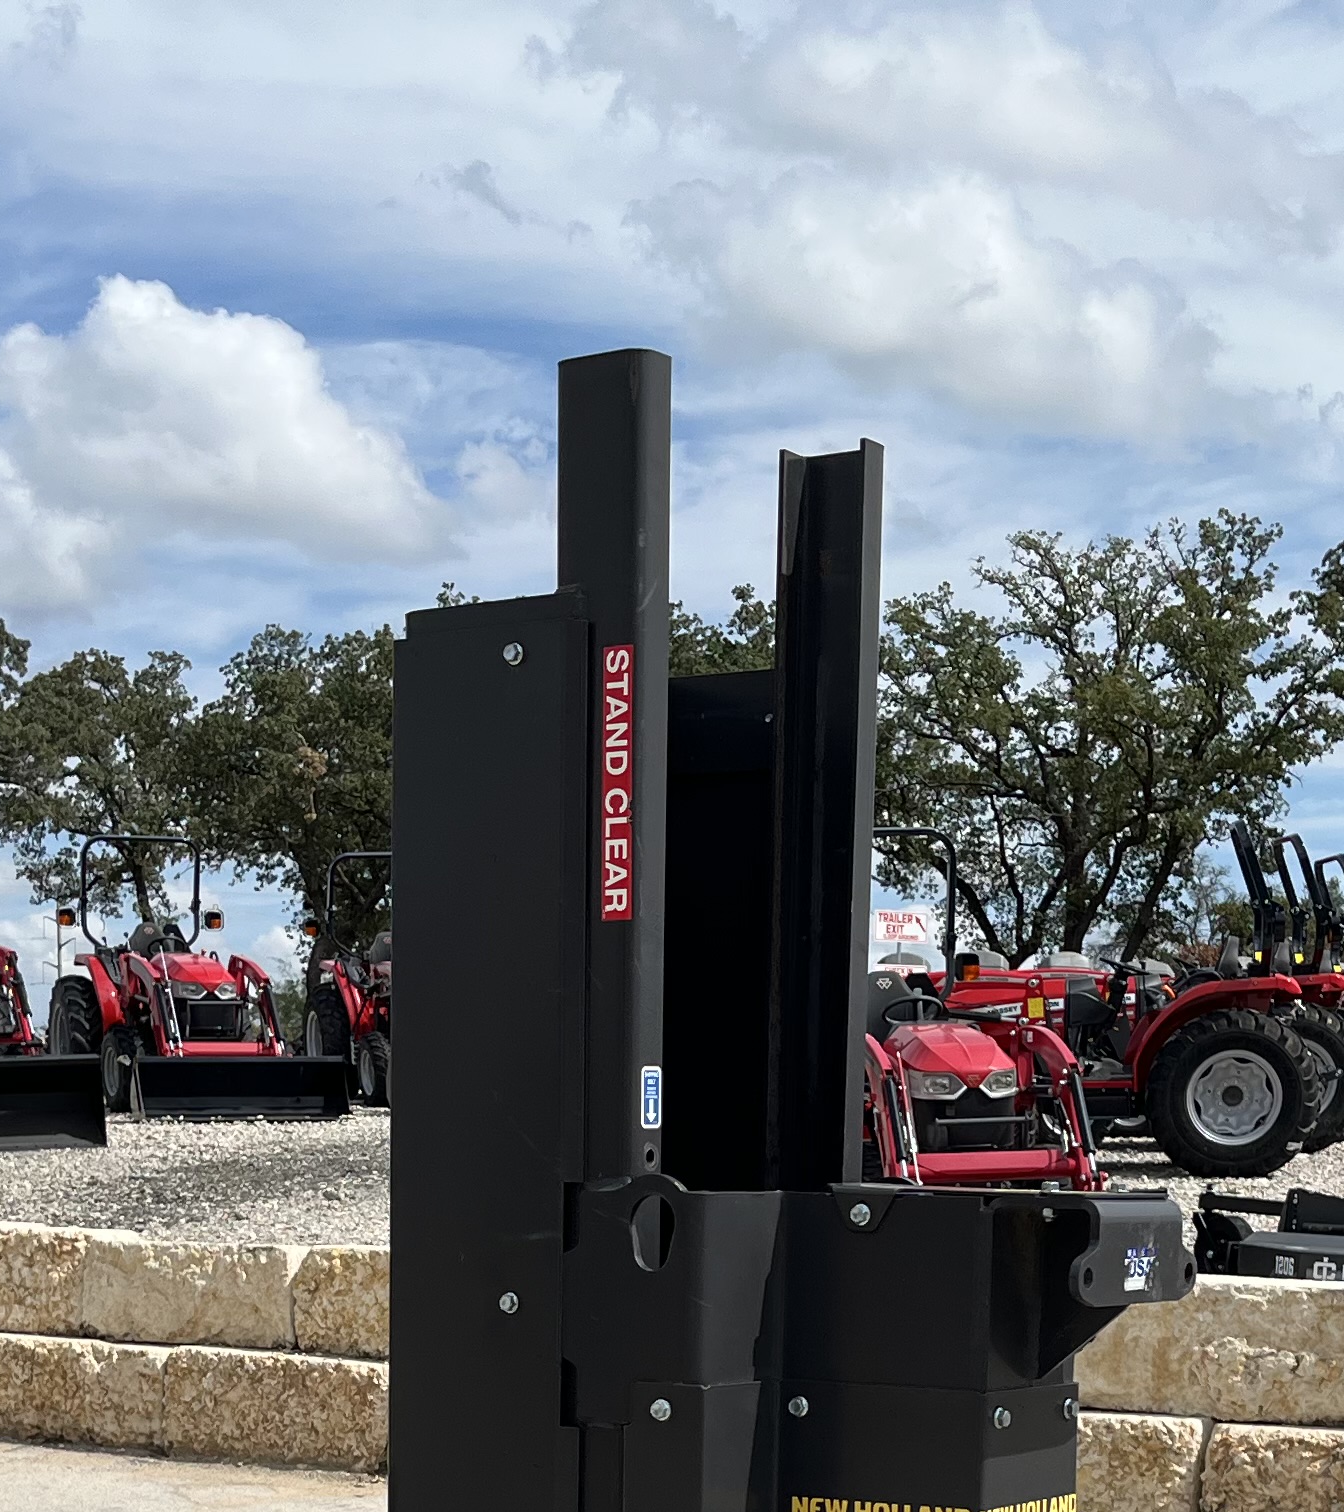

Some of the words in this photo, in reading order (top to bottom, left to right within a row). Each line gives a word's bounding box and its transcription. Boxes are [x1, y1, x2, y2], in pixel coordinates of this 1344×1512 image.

[605, 649, 630, 776] STAND
[604, 787, 629, 913] CLEAR
[878, 912, 913, 924] TRAILER
[886, 924, 904, 934] EXIT
